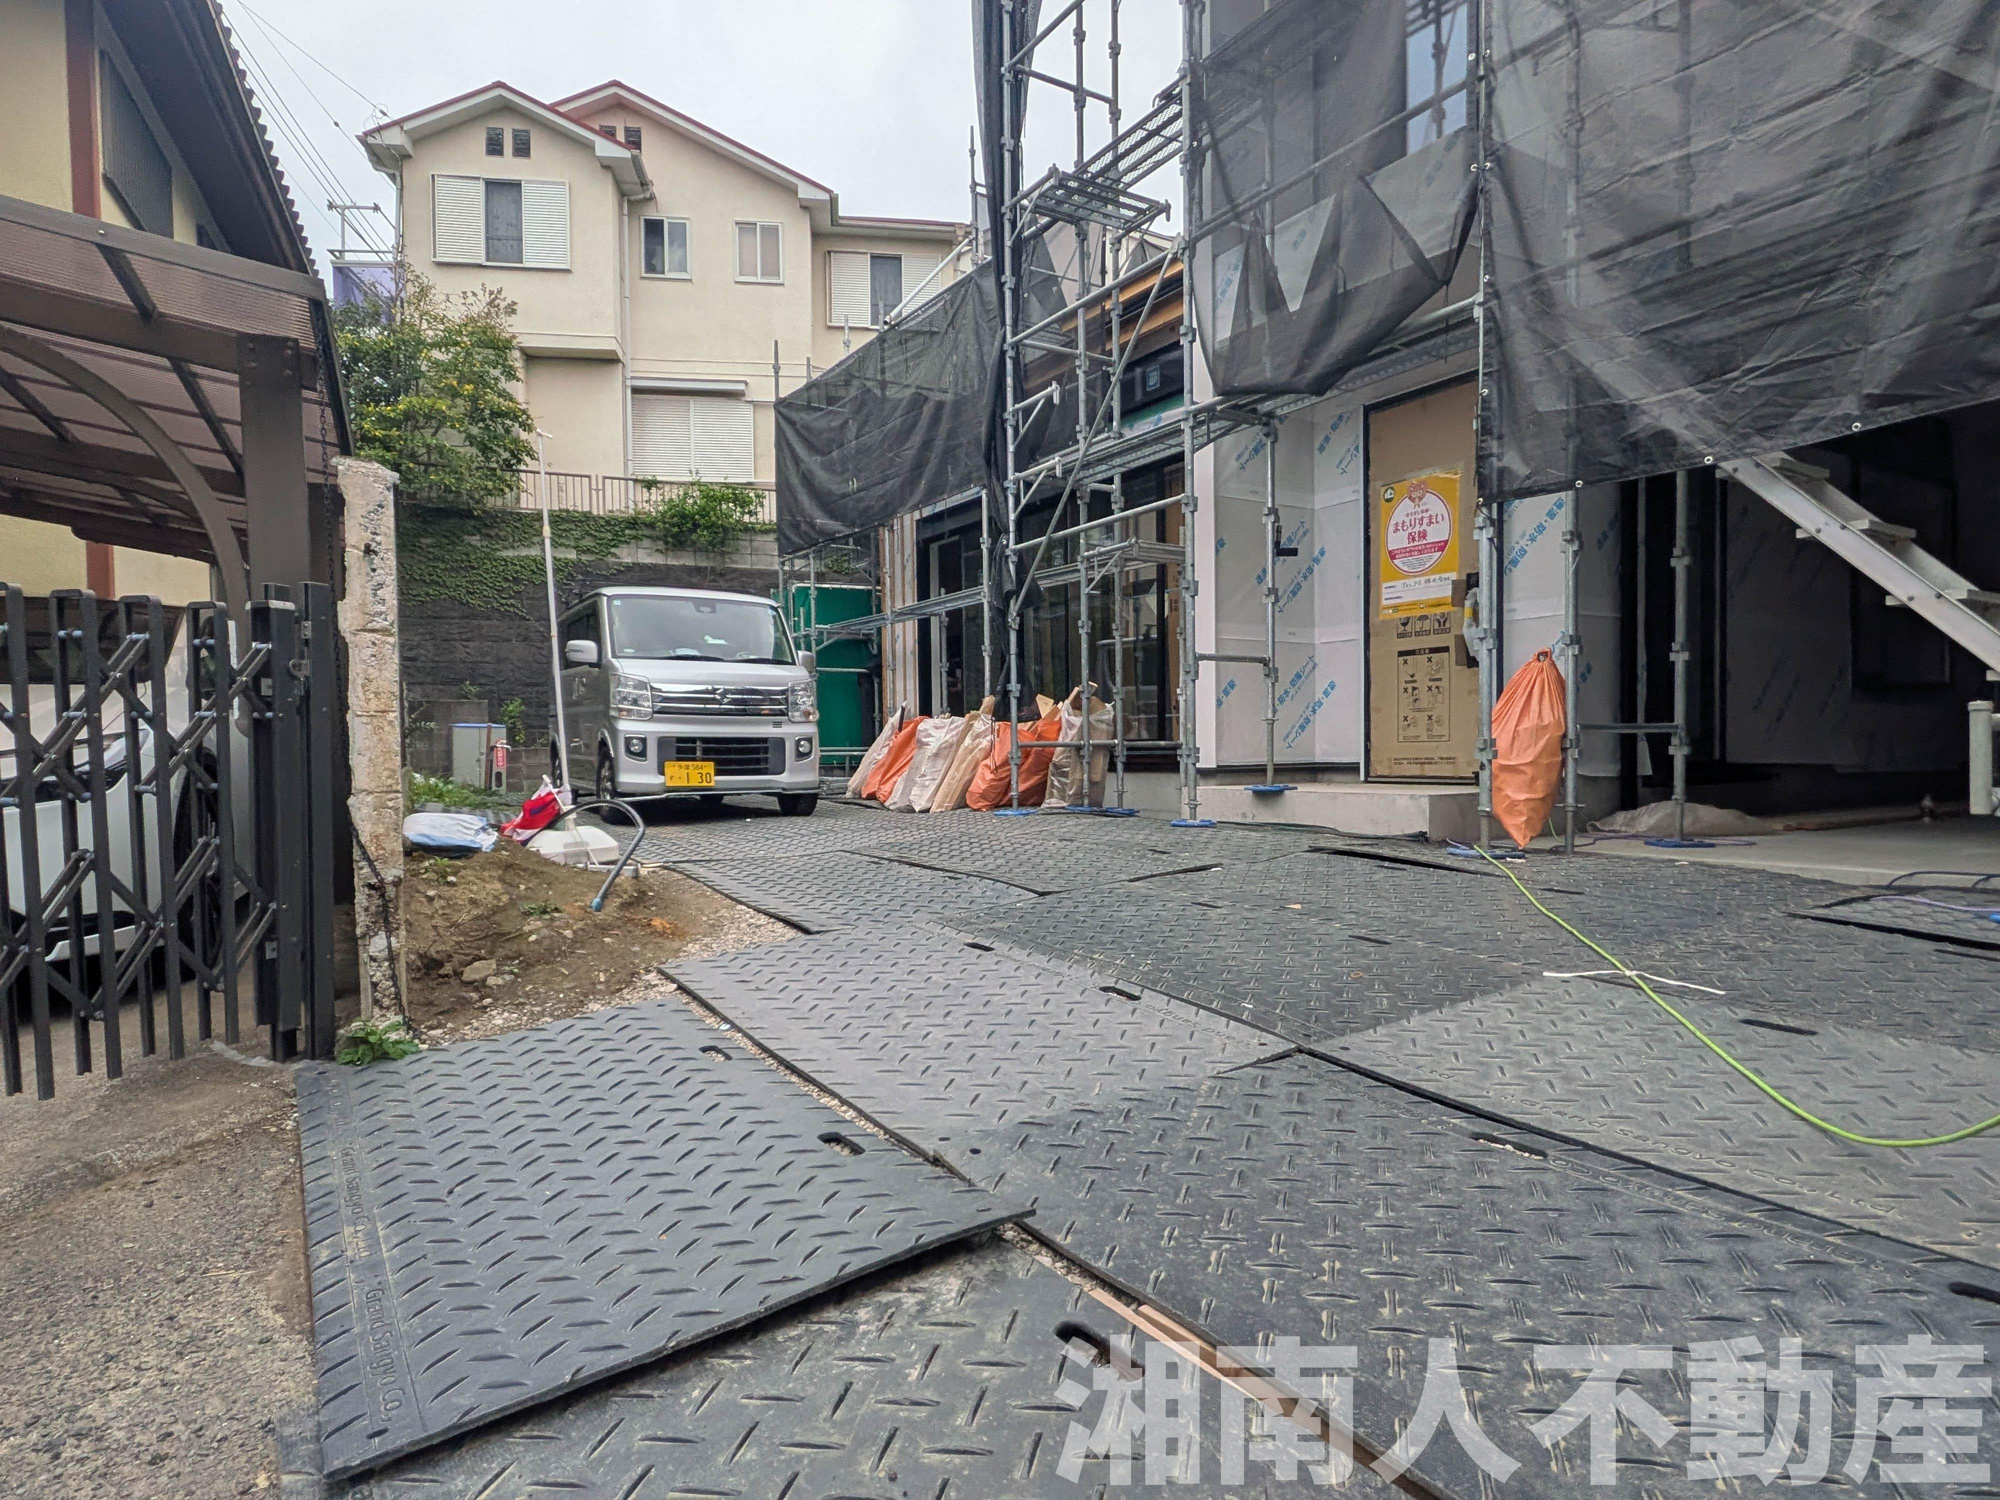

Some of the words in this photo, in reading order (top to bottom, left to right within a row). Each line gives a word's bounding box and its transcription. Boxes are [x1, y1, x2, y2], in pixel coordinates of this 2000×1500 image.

[1392, 513, 1445, 533] まもりすまい
[1406, 529, 1428, 544] 保険
[365, 1288, 392, 1330] Grand
[369, 1330, 397, 1387] Sangyo
